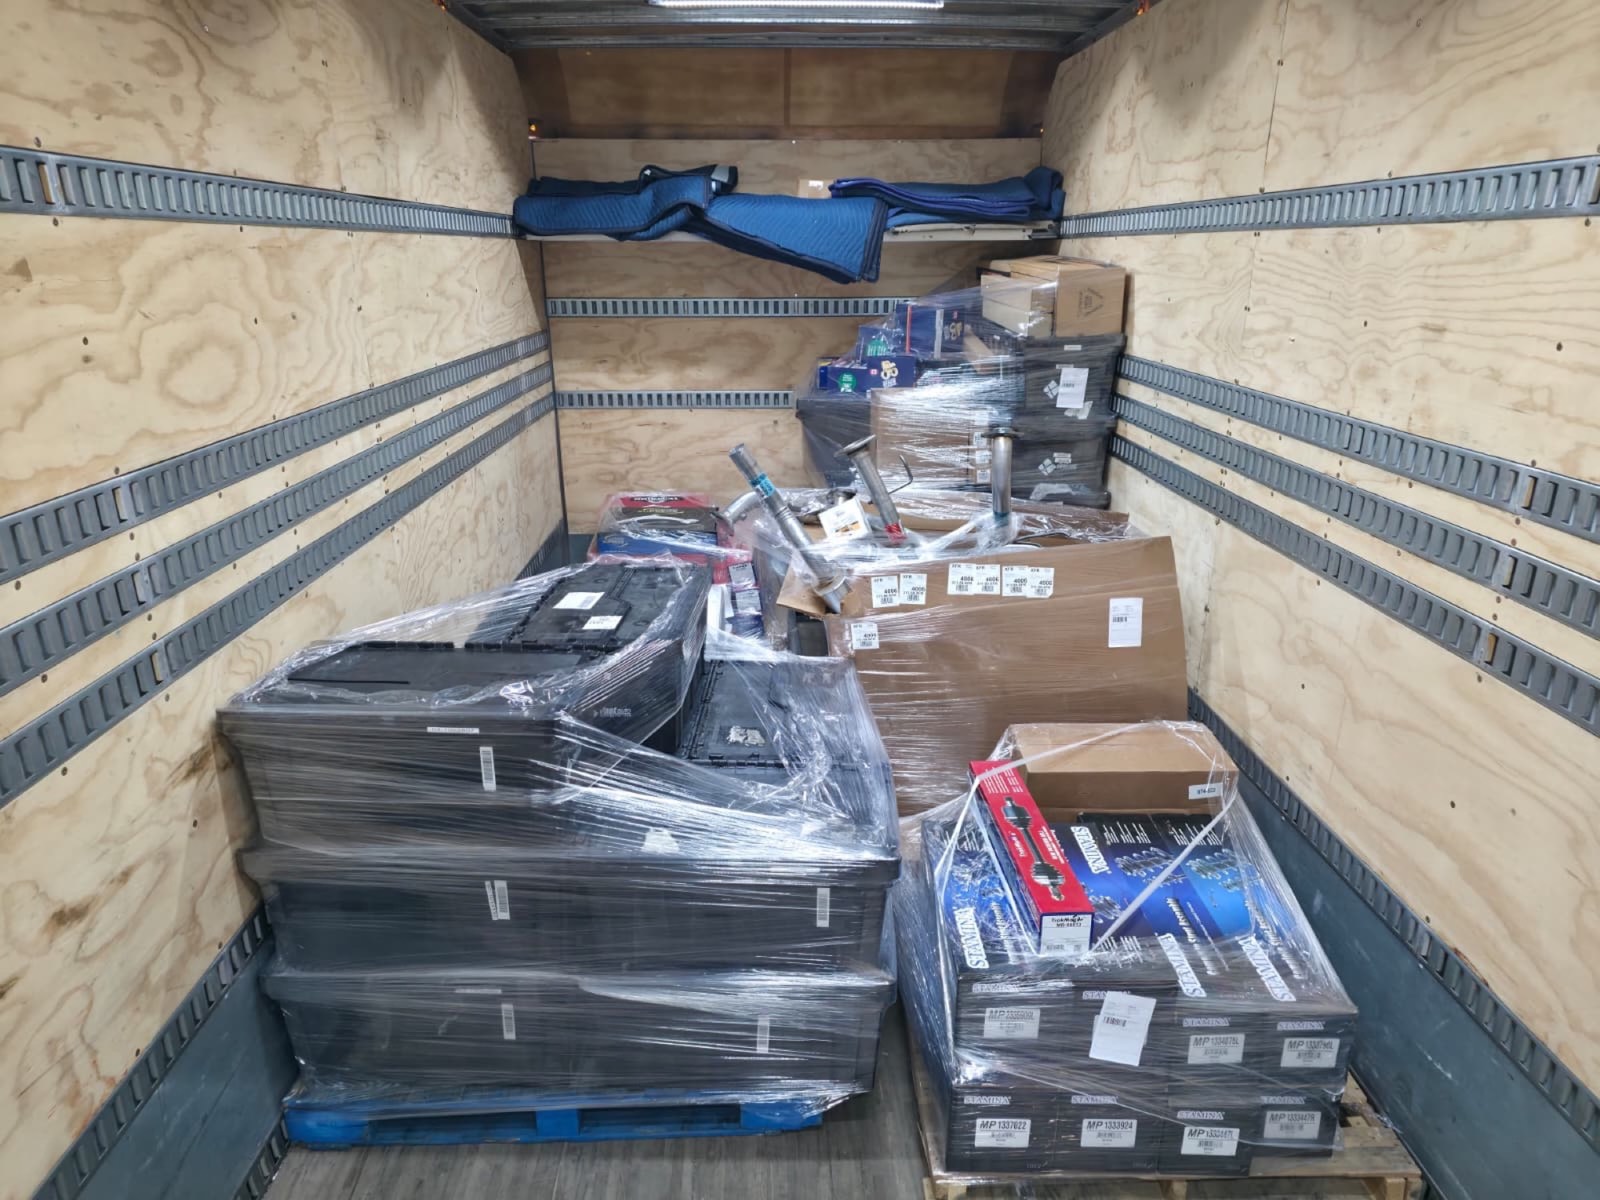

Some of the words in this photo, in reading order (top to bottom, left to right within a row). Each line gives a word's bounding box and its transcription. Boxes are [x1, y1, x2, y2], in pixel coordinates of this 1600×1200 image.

[1071, 826, 1109, 874] STAMINA
[953, 907, 989, 968] STAMINA
[1157, 932, 1207, 997] STAMINA
[1237, 935, 1297, 1001] STAMINA
[989, 1010, 1005, 1020] MP
[1183, 1017, 1230, 1027] STAMINA
[1277, 1021, 1325, 1031] STAMINA
[1193, 1037, 1210, 1046] MP
[1288, 1040, 1304, 1050] MP
[964, 1096, 1010, 1104] STAMINA
[1177, 1111, 1225, 1120] STAMINA
[1269, 1113, 1286, 1122] MP
[979, 1120, 997, 1129] MP
[1087, 1120, 1103, 1130] MP
[1187, 1128, 1204, 1138] MP
